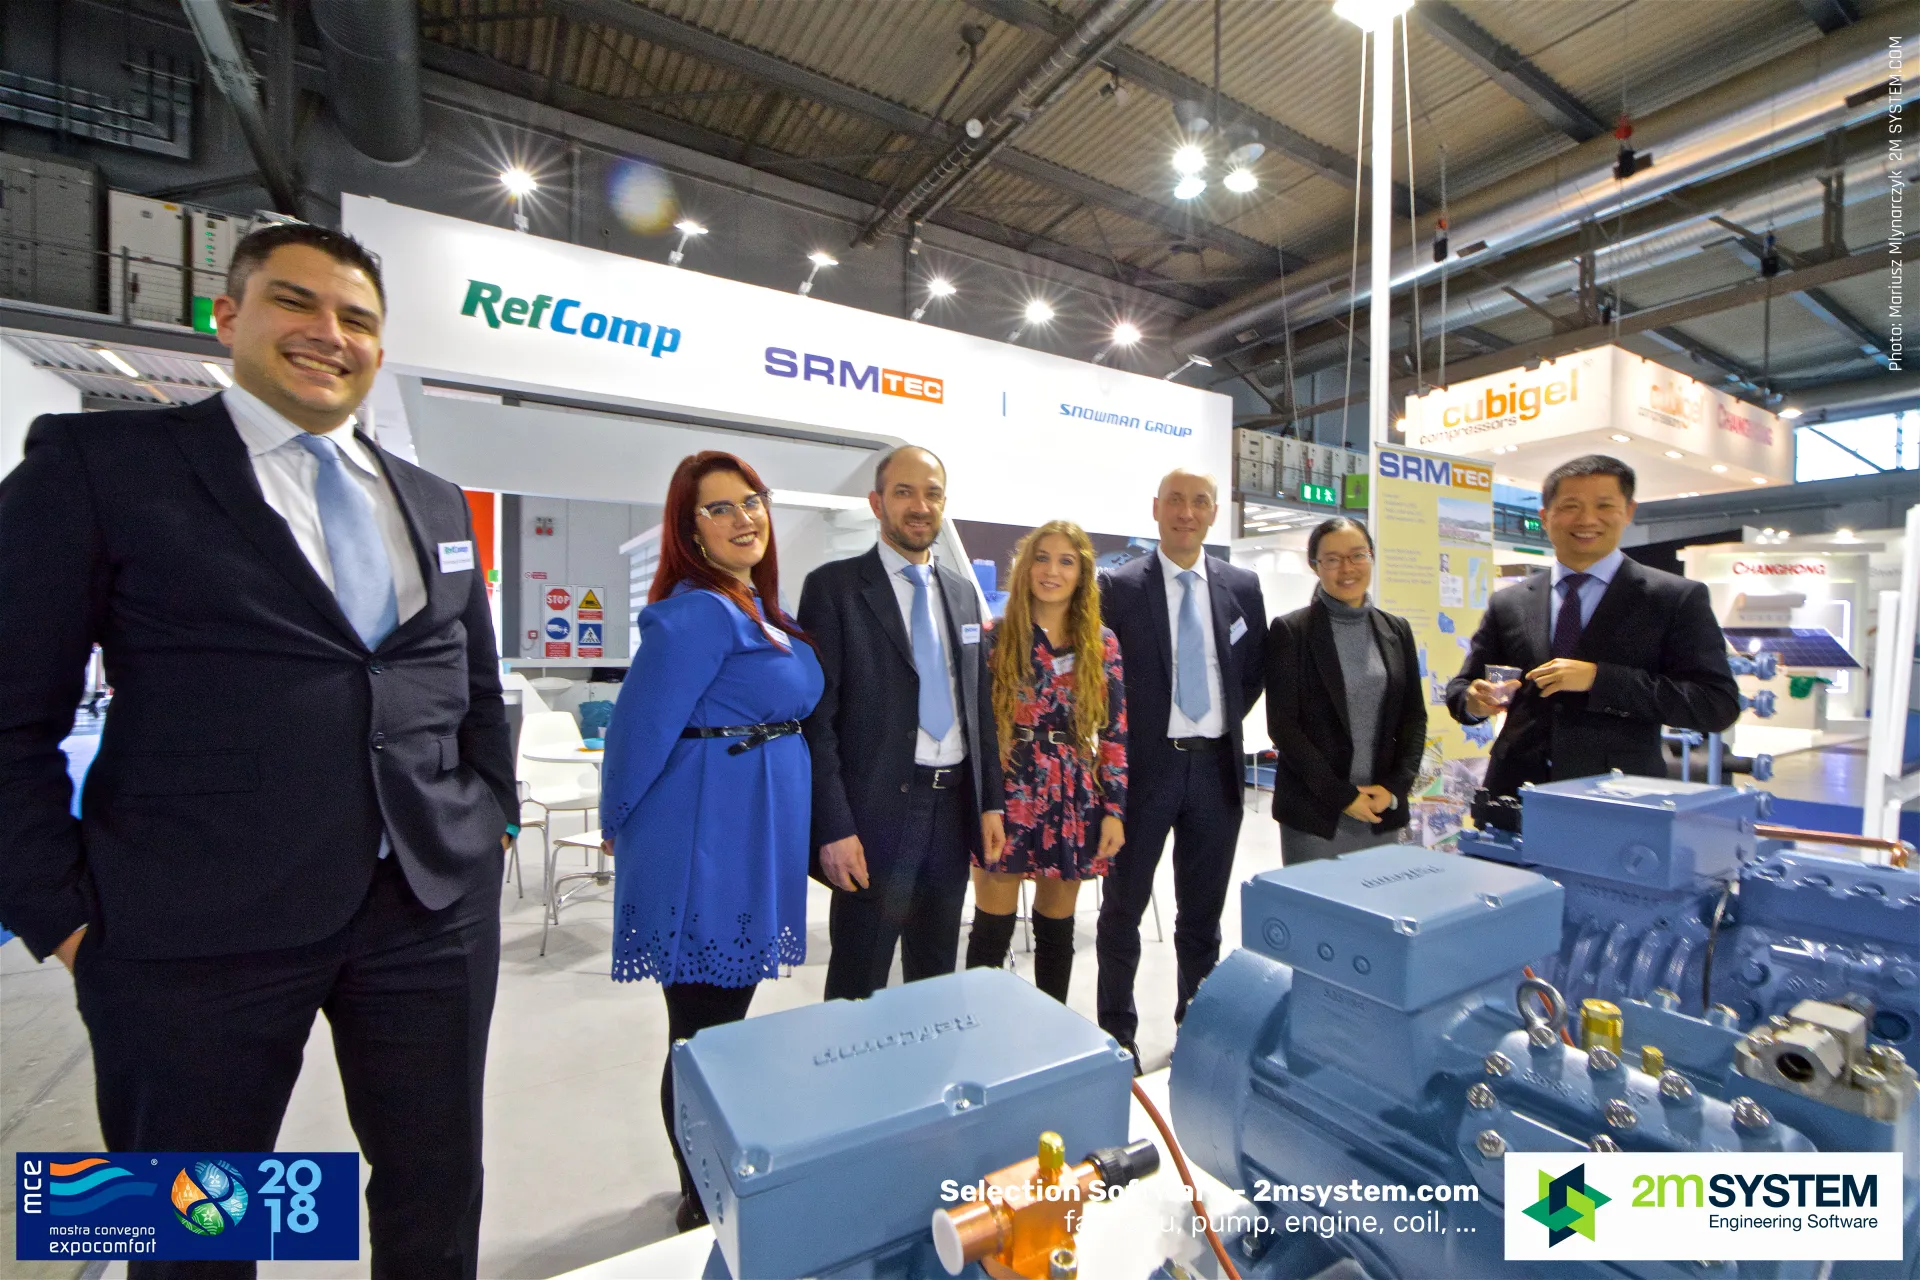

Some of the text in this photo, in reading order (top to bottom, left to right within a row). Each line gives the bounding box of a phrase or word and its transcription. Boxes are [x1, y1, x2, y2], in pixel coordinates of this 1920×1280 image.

[460, 279, 682, 358] RefComp
[1443, 368, 1579, 428] cubigel
[1059, 403, 1192, 437] SNOWMAN GROUP
[1419, 416, 1518, 445] compressors
[1732, 561, 1827, 576] CHANGHONG
[546, 595, 570, 605] STOP
